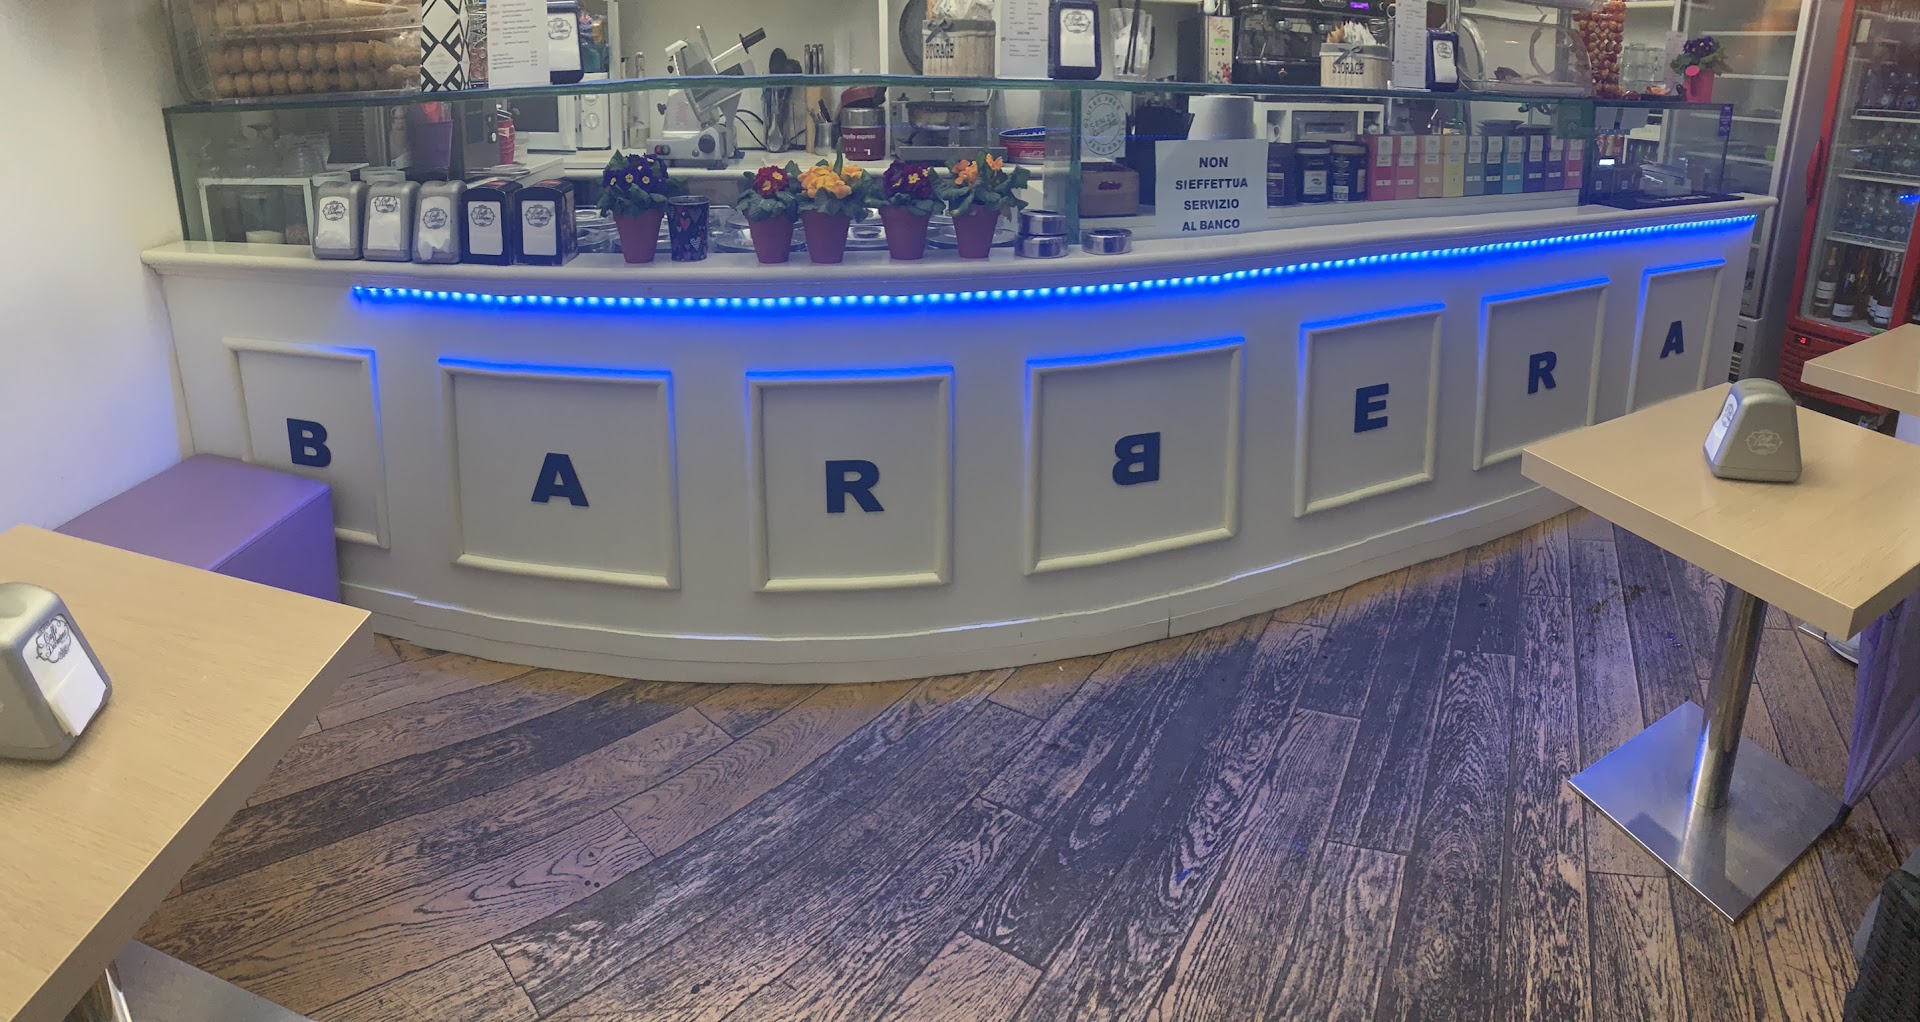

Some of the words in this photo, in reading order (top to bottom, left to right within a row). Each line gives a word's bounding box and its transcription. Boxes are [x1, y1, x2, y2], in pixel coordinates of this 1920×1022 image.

[1199, 157, 1228, 168] NON
[1184, 199, 1239, 211] SERVIZIO
[1182, 221, 1197, 231] AL
[1200, 219, 1240, 231] BANCO
